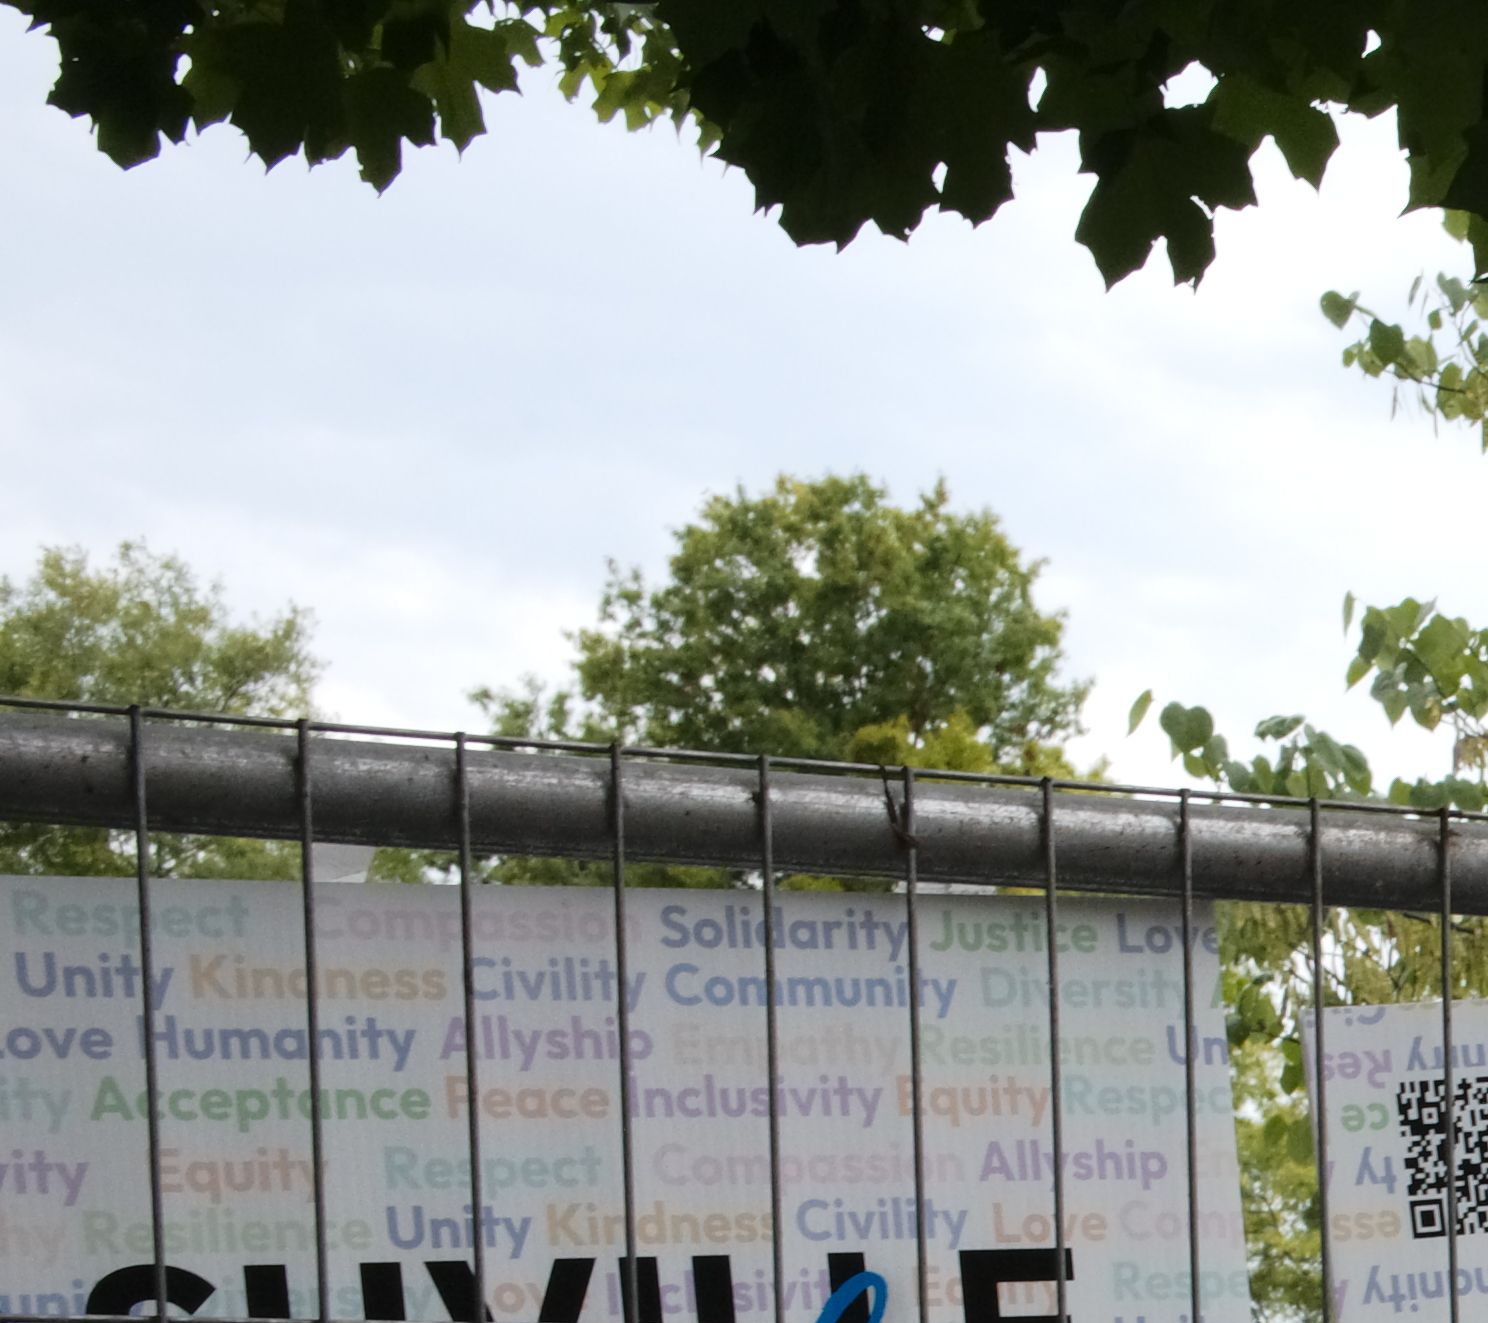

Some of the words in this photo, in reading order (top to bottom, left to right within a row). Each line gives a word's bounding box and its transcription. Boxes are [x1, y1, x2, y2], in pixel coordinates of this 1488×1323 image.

[659, 905, 908, 962] Solidarity
[929, 910, 1098, 954] Justice
[1115, 913, 1219, 955] Love
[15, 951, 174, 1010] Unity
[470, 957, 645, 1011] Civility
[665, 962, 958, 1018] Community
[137, 1013, 416, 1072] Humanity
[439, 1014, 653, 1072] Allyship
[90, 1076, 431, 1133] Acceptance
[444, 1075, 609, 1120] Peace
[628, 1072, 883, 1128] Inclusivity
[385, 1205, 532, 1259] Unity
[796, 1200, 968, 1250] Civility
[992, 1202, 1108, 1245] Love
